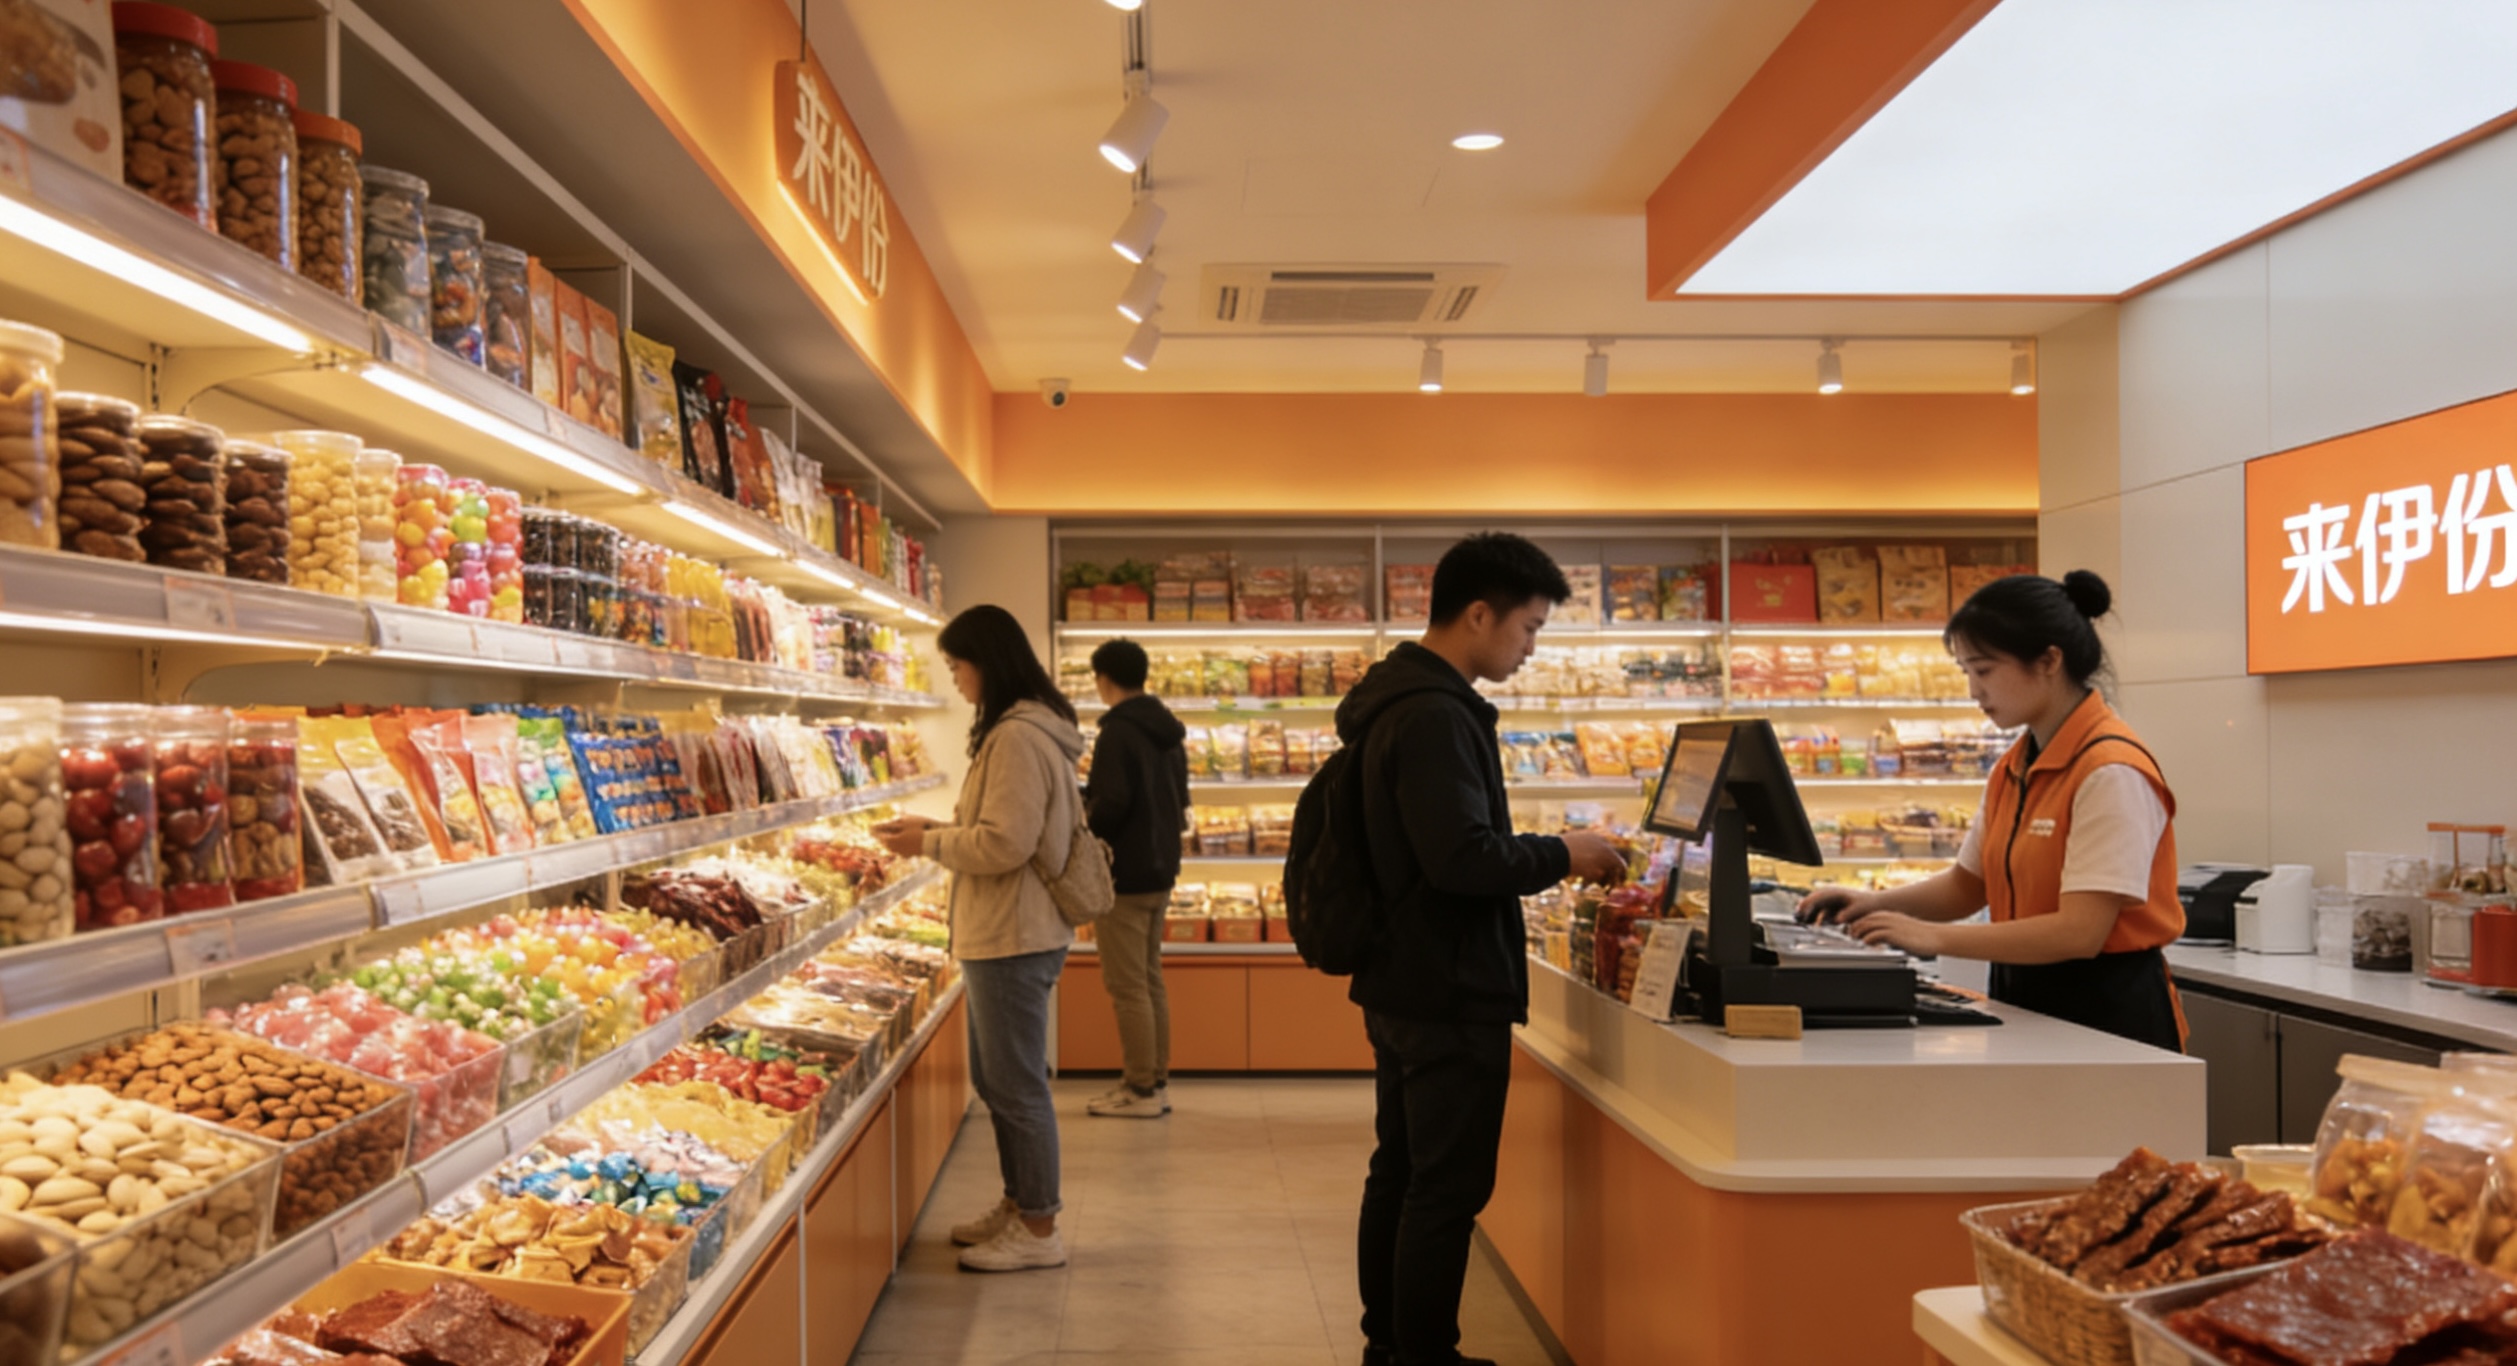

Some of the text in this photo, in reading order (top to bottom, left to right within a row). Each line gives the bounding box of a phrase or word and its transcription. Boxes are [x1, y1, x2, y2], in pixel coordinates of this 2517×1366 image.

[792, 70, 889, 299] 来伊份
[2281, 463, 2517, 615] 来伊份
